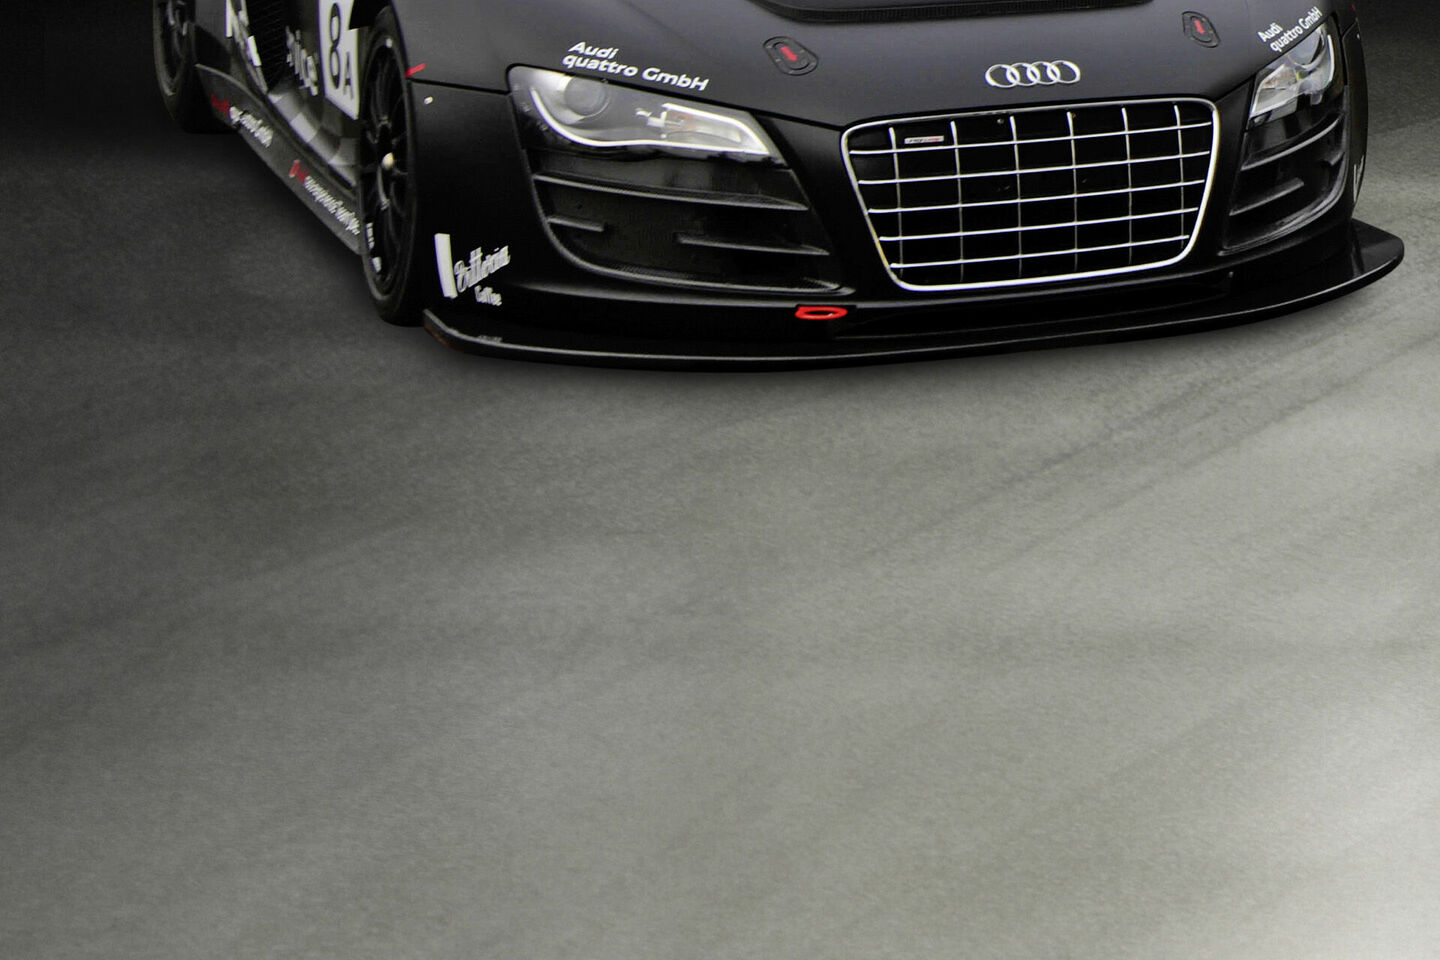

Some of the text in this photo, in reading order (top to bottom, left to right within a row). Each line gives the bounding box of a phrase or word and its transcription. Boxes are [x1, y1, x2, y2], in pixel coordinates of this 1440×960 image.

[1257, 22, 1283, 43] Audi
[1269, 6, 1324, 53] quattro GmbH
[568, 41, 620, 60] Audi
[562, 54, 710, 91] quattro GmbH
